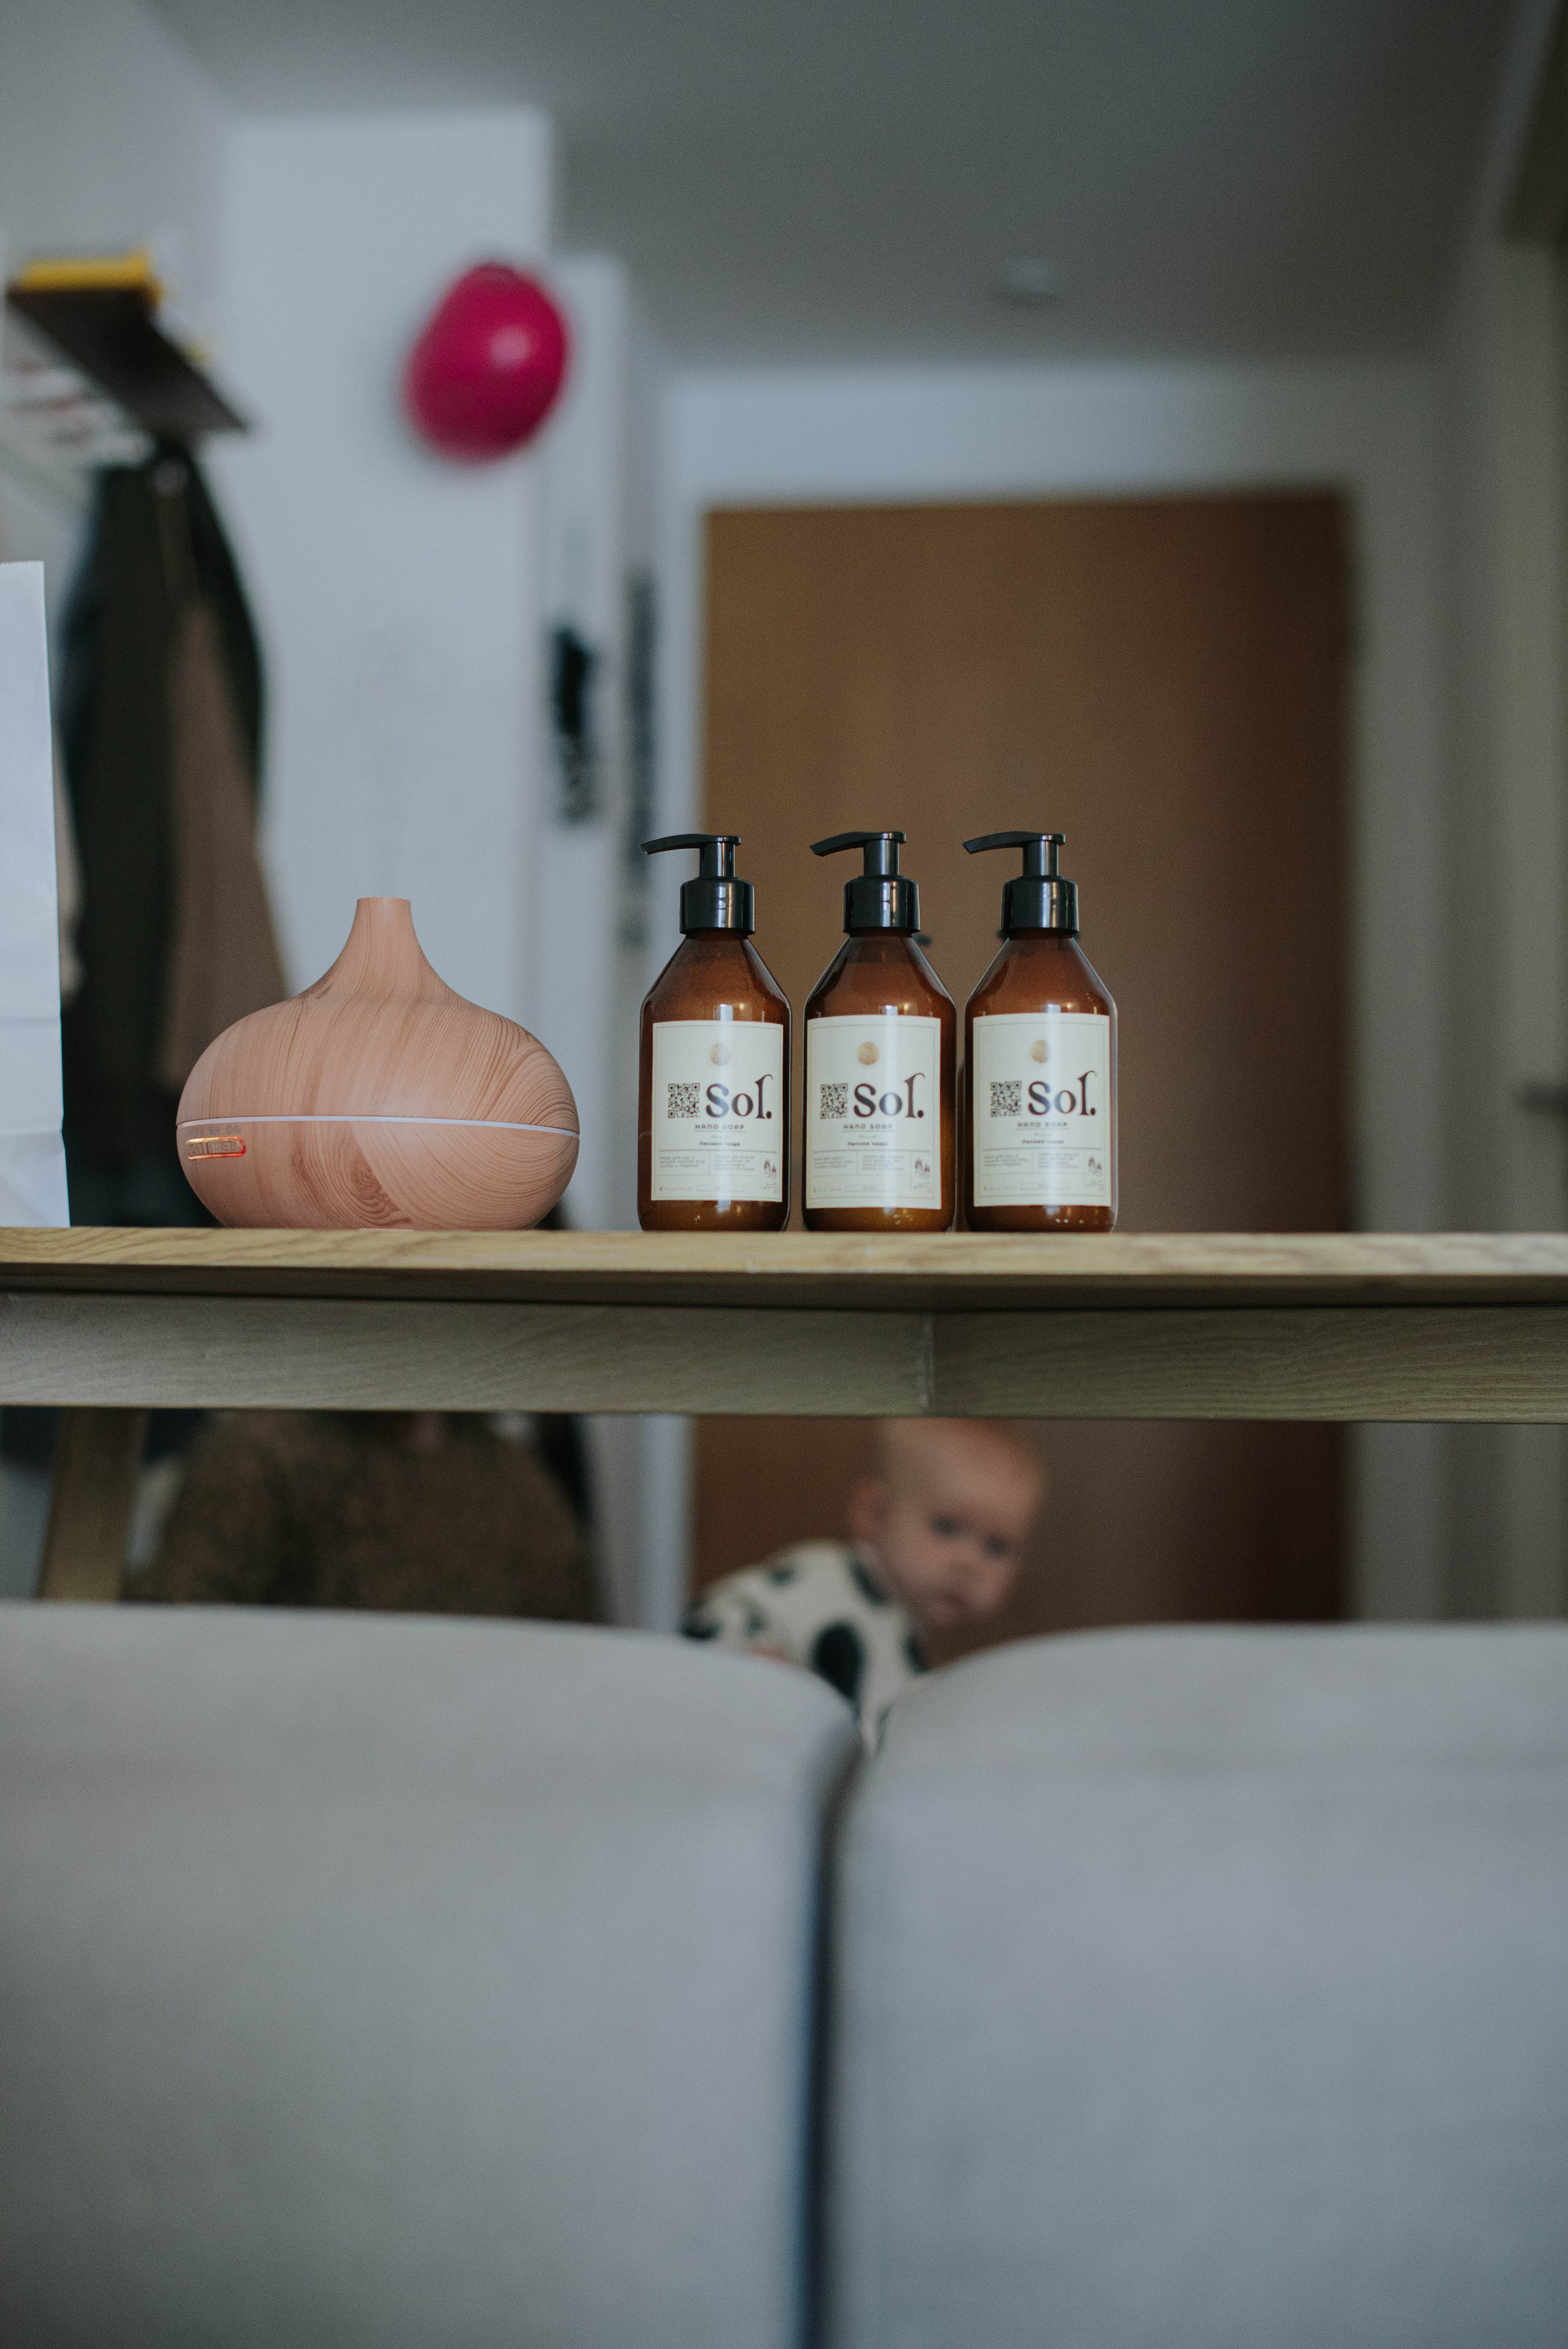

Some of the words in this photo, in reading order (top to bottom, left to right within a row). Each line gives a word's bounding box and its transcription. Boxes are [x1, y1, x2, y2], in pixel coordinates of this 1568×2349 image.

[706, 1074, 774, 1119] Sol.
[853, 1073, 926, 1118] Sol.
[1028, 1070, 1097, 1115] Sol.
